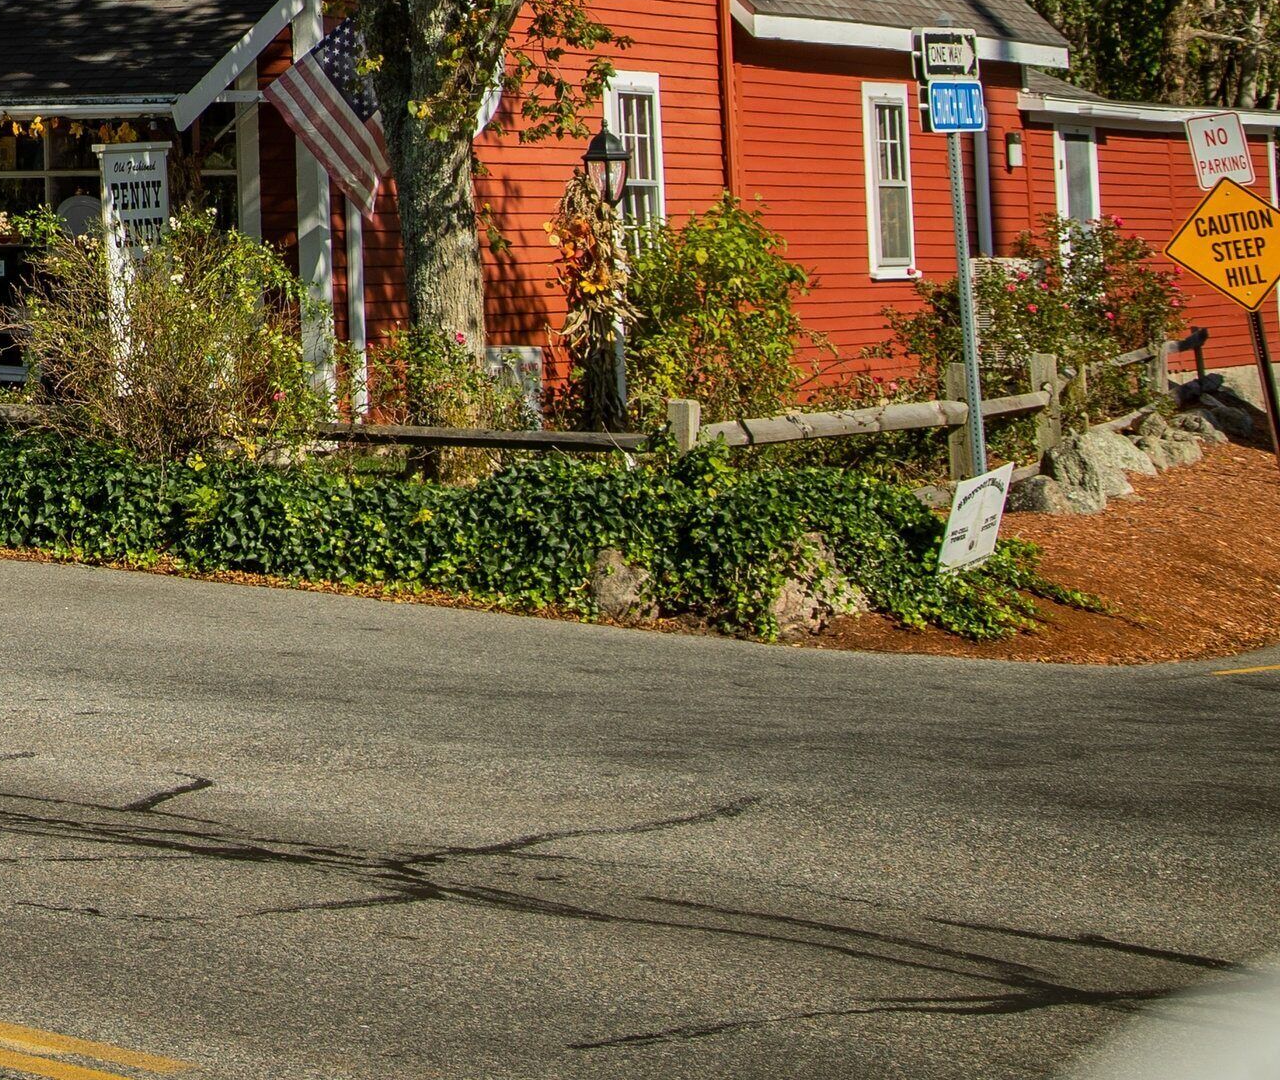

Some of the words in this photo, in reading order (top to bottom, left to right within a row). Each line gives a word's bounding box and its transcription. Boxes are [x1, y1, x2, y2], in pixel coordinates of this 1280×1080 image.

[931, 46, 947, 62] ONE
[948, 46, 962, 64] WAY
[1204, 127, 1228, 147] NO
[113, 161, 126, 173] Old
[126, 160, 156, 174] Fashioned
[1199, 154, 1248, 176] PARKING
[111, 180, 162, 211] PENNY
[1194, 208, 1274, 238] CAUTION
[1211, 236, 1266, 263] STEEP
[1225, 264, 1268, 288] HILL
